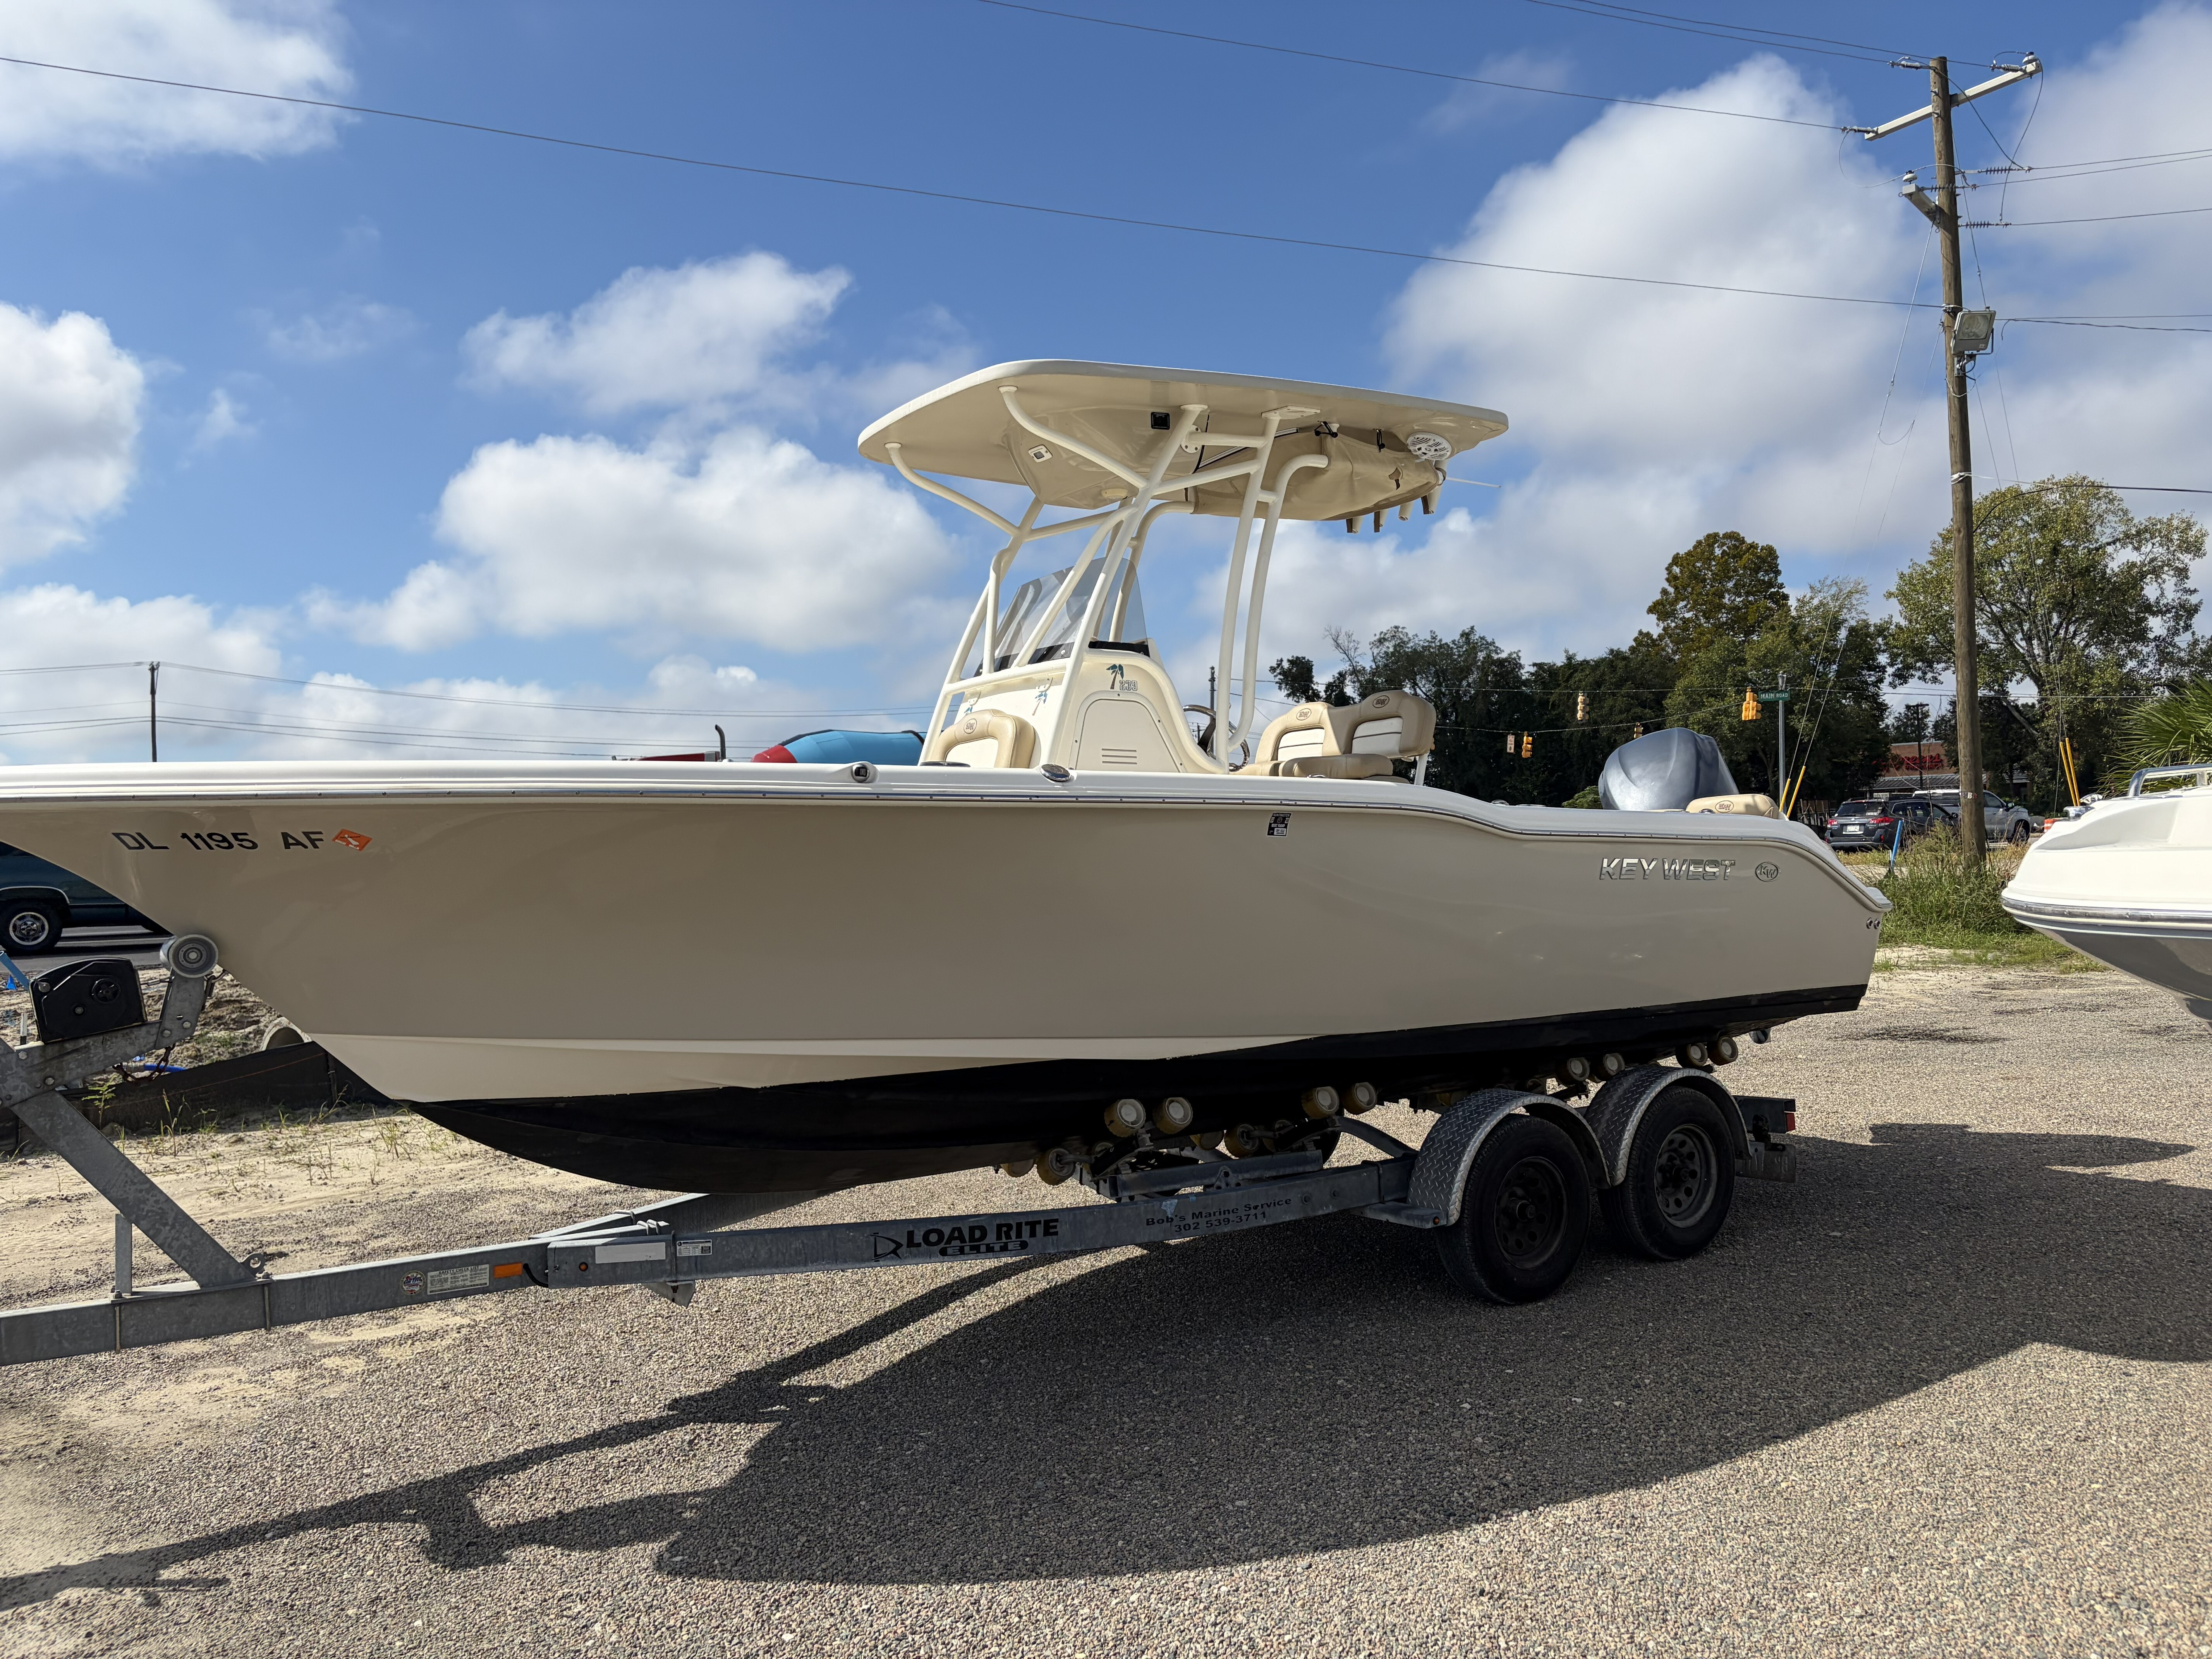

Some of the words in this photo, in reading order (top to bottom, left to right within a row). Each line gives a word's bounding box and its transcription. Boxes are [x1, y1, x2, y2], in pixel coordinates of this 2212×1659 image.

[1119, 680, 1138, 691] 239
[112, 832, 170, 850] DL
[180, 832, 259, 850] 1195
[281, 831, 324, 850] AF
[1599, 858, 1658, 880] KEY
[1662, 858, 1737, 881] WEST
[1759, 864, 1777, 879] KW
[1146, 1214, 1186, 1226] Bob's
[1192, 1207, 1239, 1220] Marine
[1244, 1199, 1291, 1212] Service
[1174, 1222, 1200, 1233] 302
[1206, 1211, 1266, 1228] 539-3711
[906, 1225, 988, 1249] LOAD
[995, 1218, 1059, 1241] RITE
[946, 1241, 1022, 1256] ELITE
